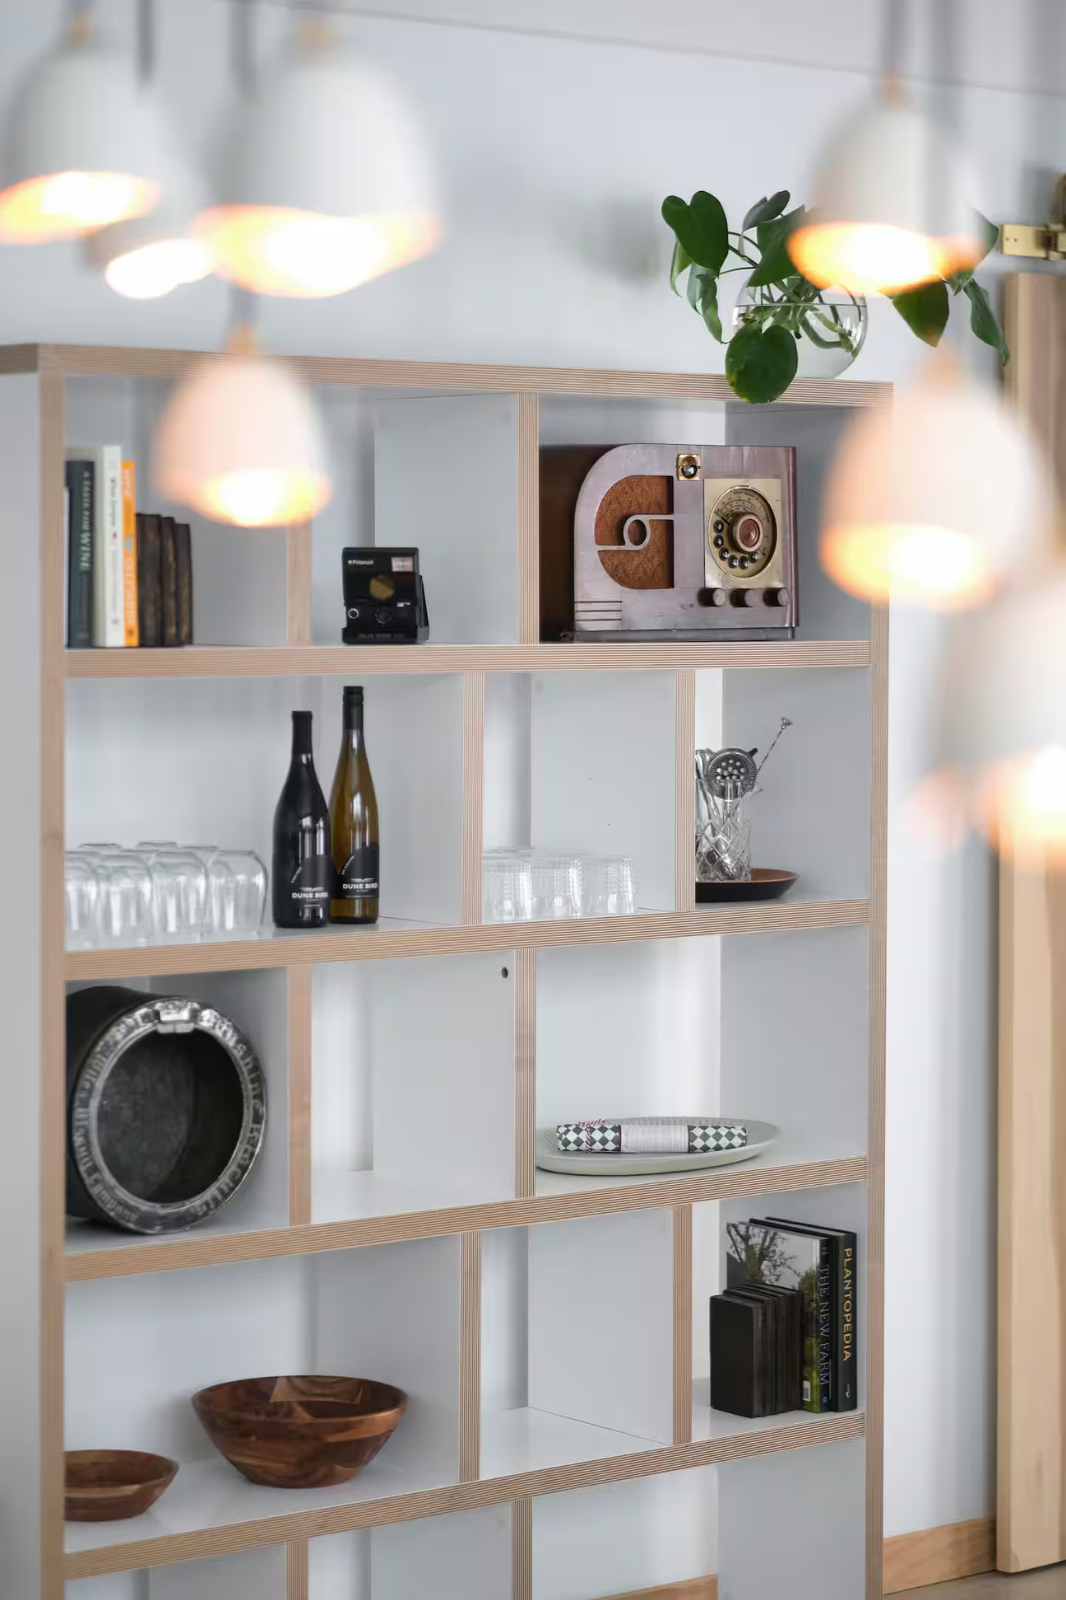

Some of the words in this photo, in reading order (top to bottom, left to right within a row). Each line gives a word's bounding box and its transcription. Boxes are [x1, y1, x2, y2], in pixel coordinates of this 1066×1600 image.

[79, 531, 92, 571] WINE
[819, 1264, 830, 1297] THE
[819, 1302, 830, 1338] NEW
[843, 1247, 853, 1362] PLANTOPEDIA
[819, 1343, 830, 1385] FARM
